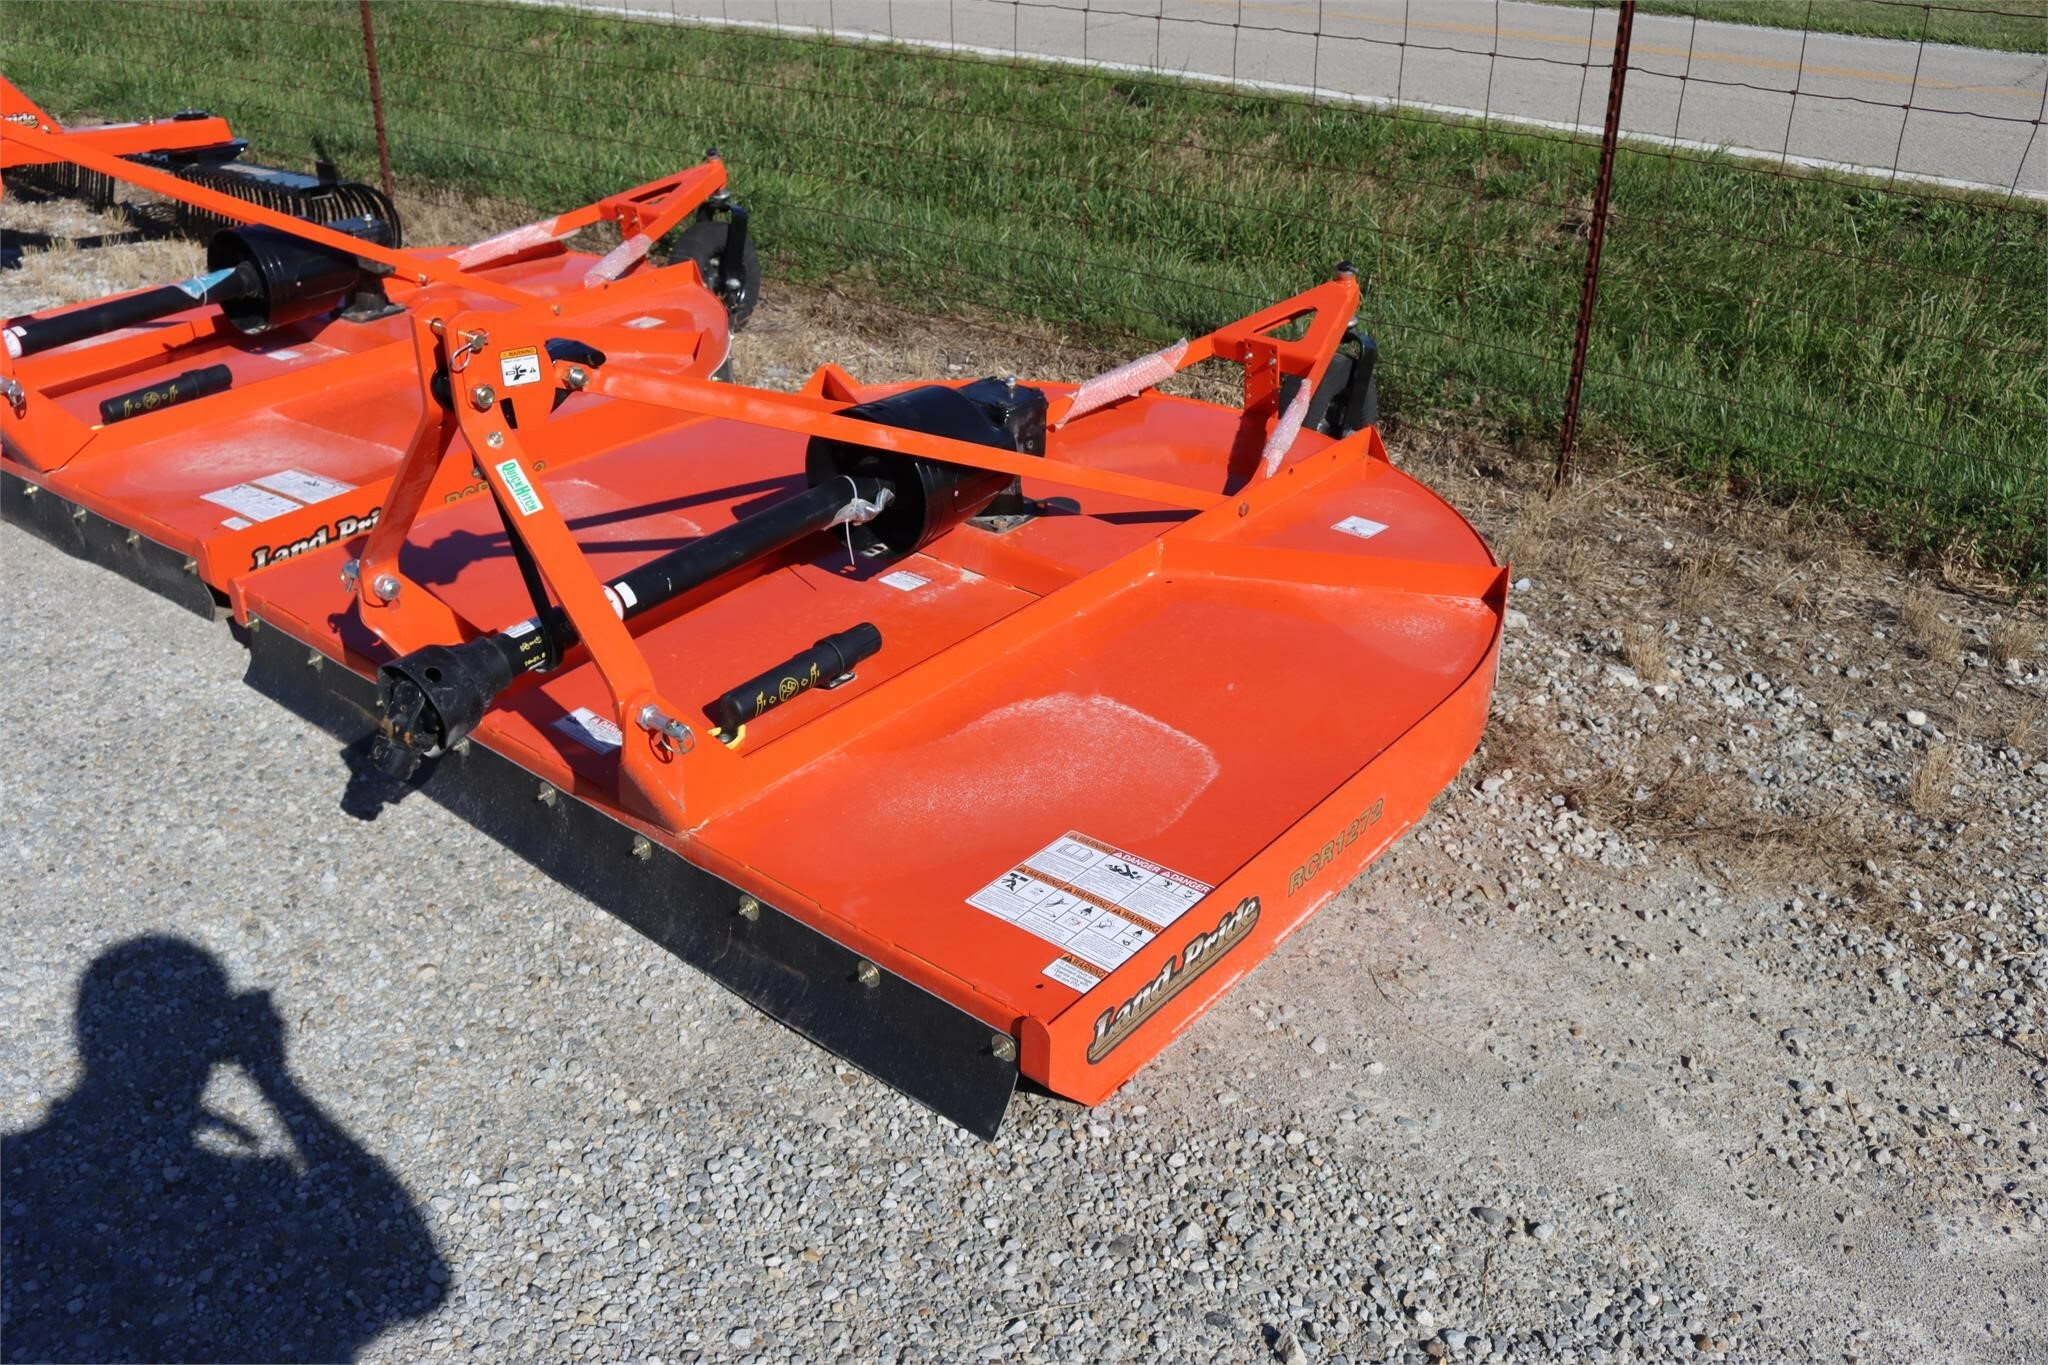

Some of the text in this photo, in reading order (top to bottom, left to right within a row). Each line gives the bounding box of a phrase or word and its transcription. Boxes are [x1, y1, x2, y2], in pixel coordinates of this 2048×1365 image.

[252, 507, 382, 569] Land Pri
[1077, 835, 1114, 854] WARNING
[1288, 798, 1384, 897] RCR1272
[1121, 854, 1162, 873] DANGER
[1027, 869, 1063, 888] WARNING
[1169, 873, 1211, 894] DANGER
[1073, 888, 1111, 910] WARNING
[1121, 911, 1161, 934] WARNING
[1072, 958, 1106, 978] WARNING
[1093, 955, 1176, 1048] Land
[1183, 897, 1260, 972] Pride
